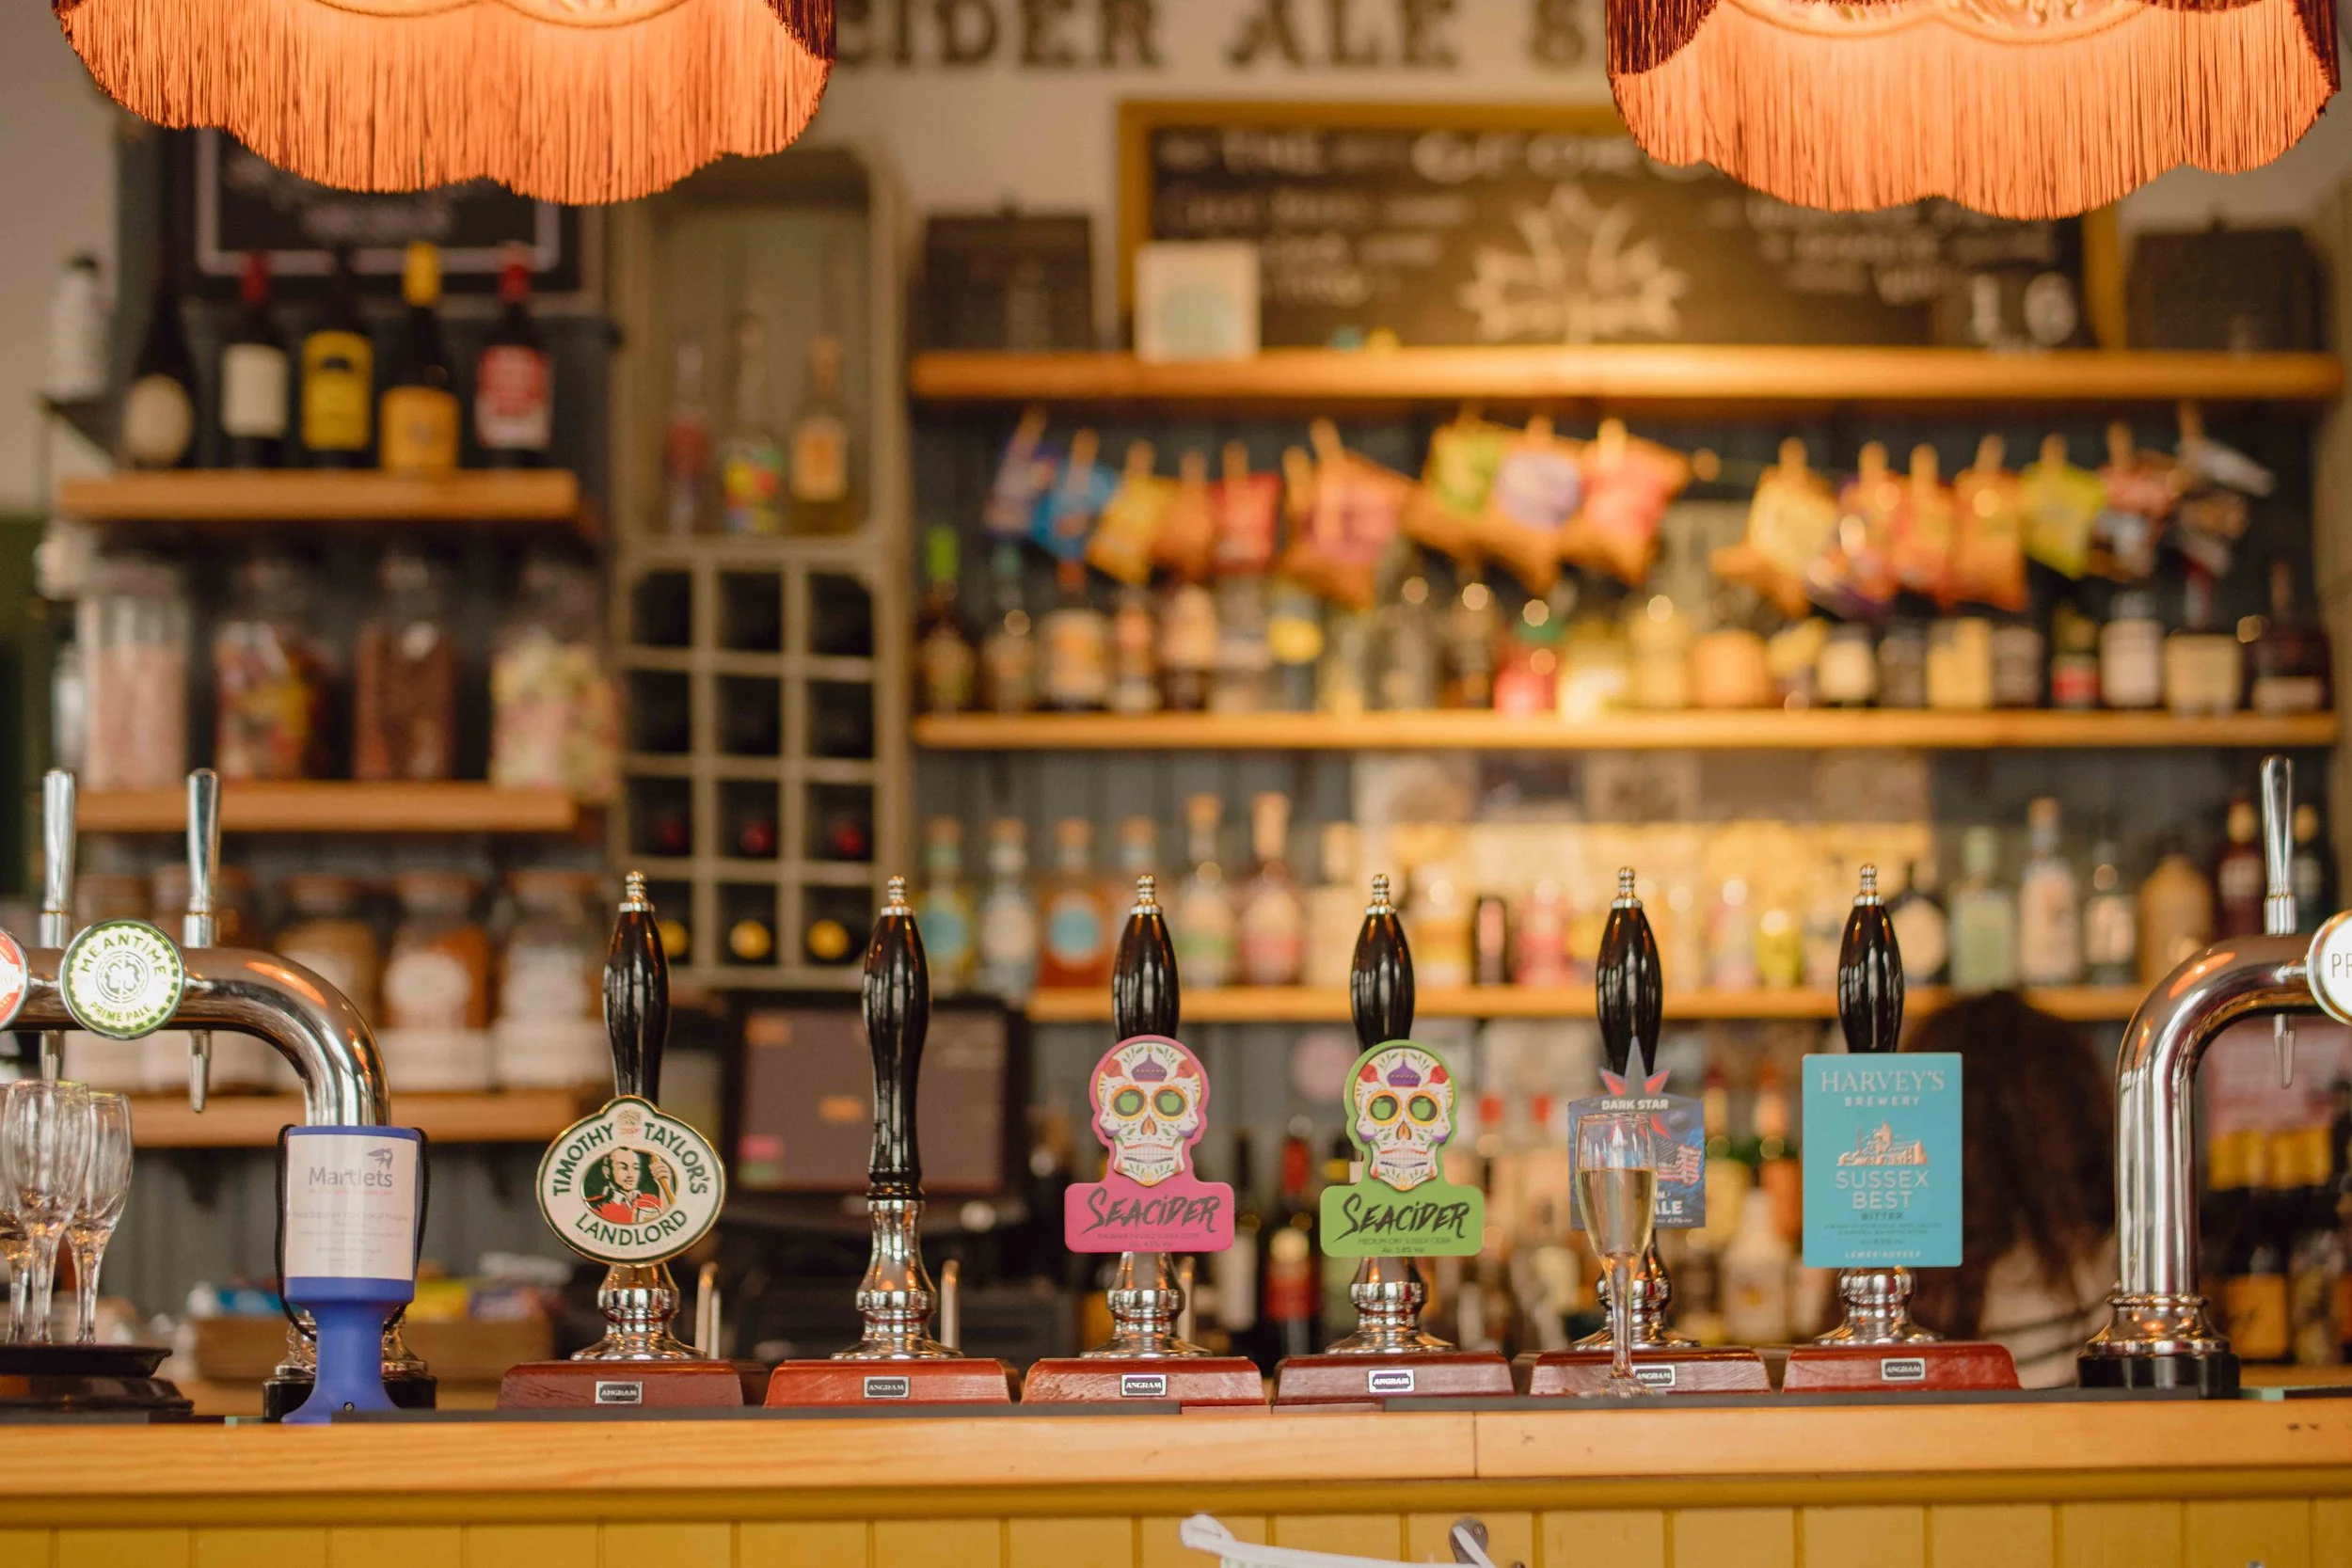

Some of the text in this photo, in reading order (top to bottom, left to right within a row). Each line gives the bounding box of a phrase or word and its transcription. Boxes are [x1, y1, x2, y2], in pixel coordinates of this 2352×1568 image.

[1222, 0, 1457, 69] ALE
[80, 933, 167, 976] MEANTIME
[89, 1002, 122, 1022] PRIME
[126, 1006, 151, 1022] PALE
[1820, 1070, 1946, 1093] HARVEY'S
[1601, 1099, 1669, 1111] DARK STAR
[1844, 1096, 1920, 1107] BREWERY
[553, 1122, 708, 1196] TIMOTHY TAYLOR'S
[309, 1166, 393, 1188] Martlets
[1836, 1170, 1929, 1190] SUSSEX
[1851, 1191, 1913, 1210] BEST
[1861, 1212, 1904, 1221] BITTER
[575, 1210, 688, 1246] LANDLORD
